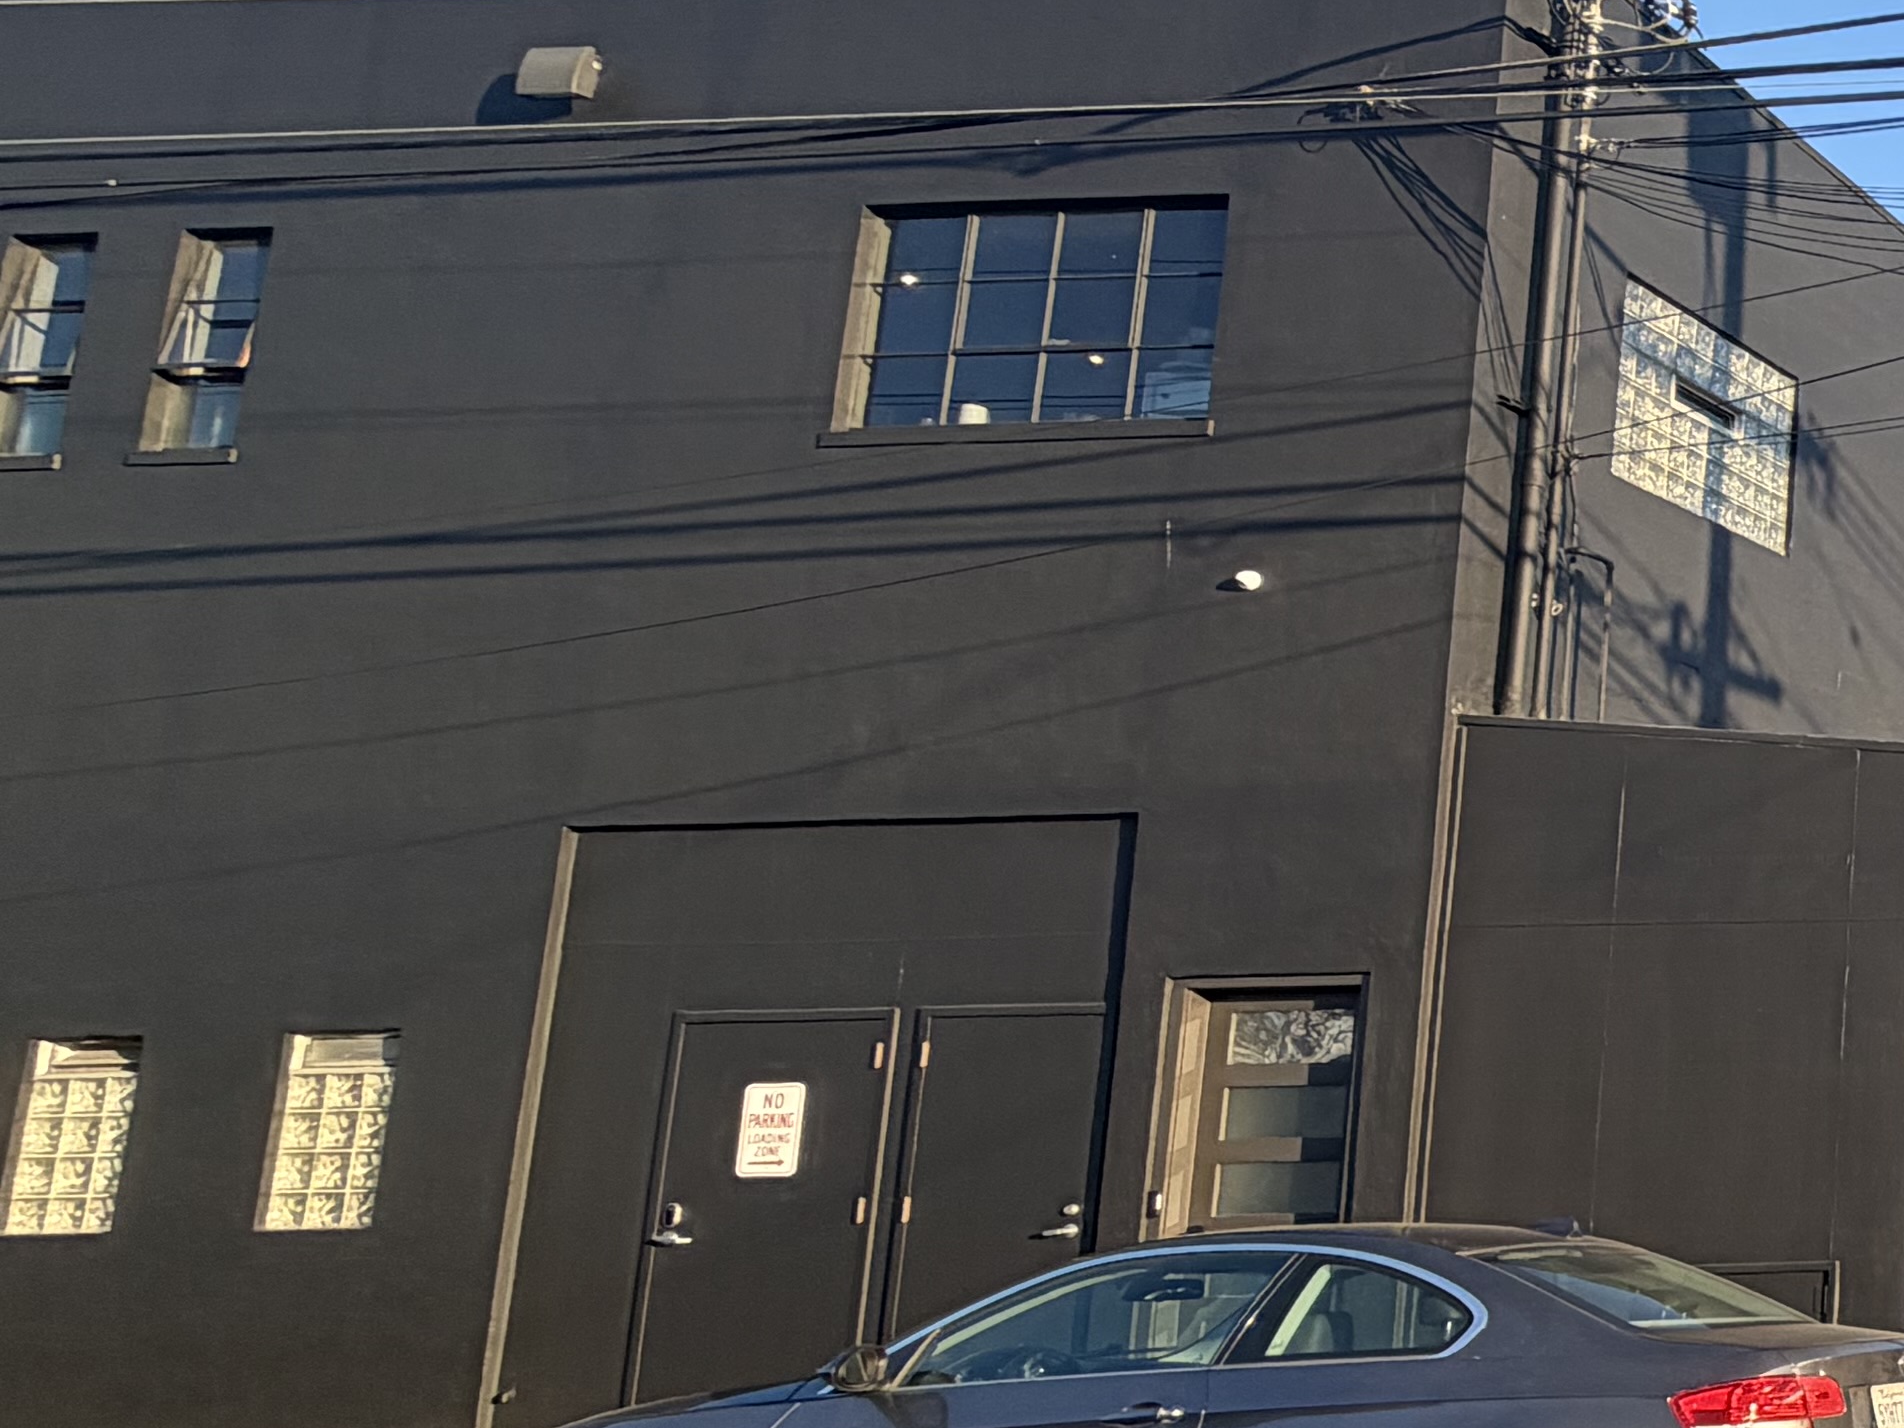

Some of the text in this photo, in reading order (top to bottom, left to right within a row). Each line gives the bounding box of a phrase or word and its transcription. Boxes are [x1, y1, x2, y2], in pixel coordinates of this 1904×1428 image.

[763, 1093, 784, 1109] NO
[747, 1112, 795, 1128] PARKING
[747, 1132, 791, 1145] LOADING
[754, 1145, 781, 1157] ZONE
